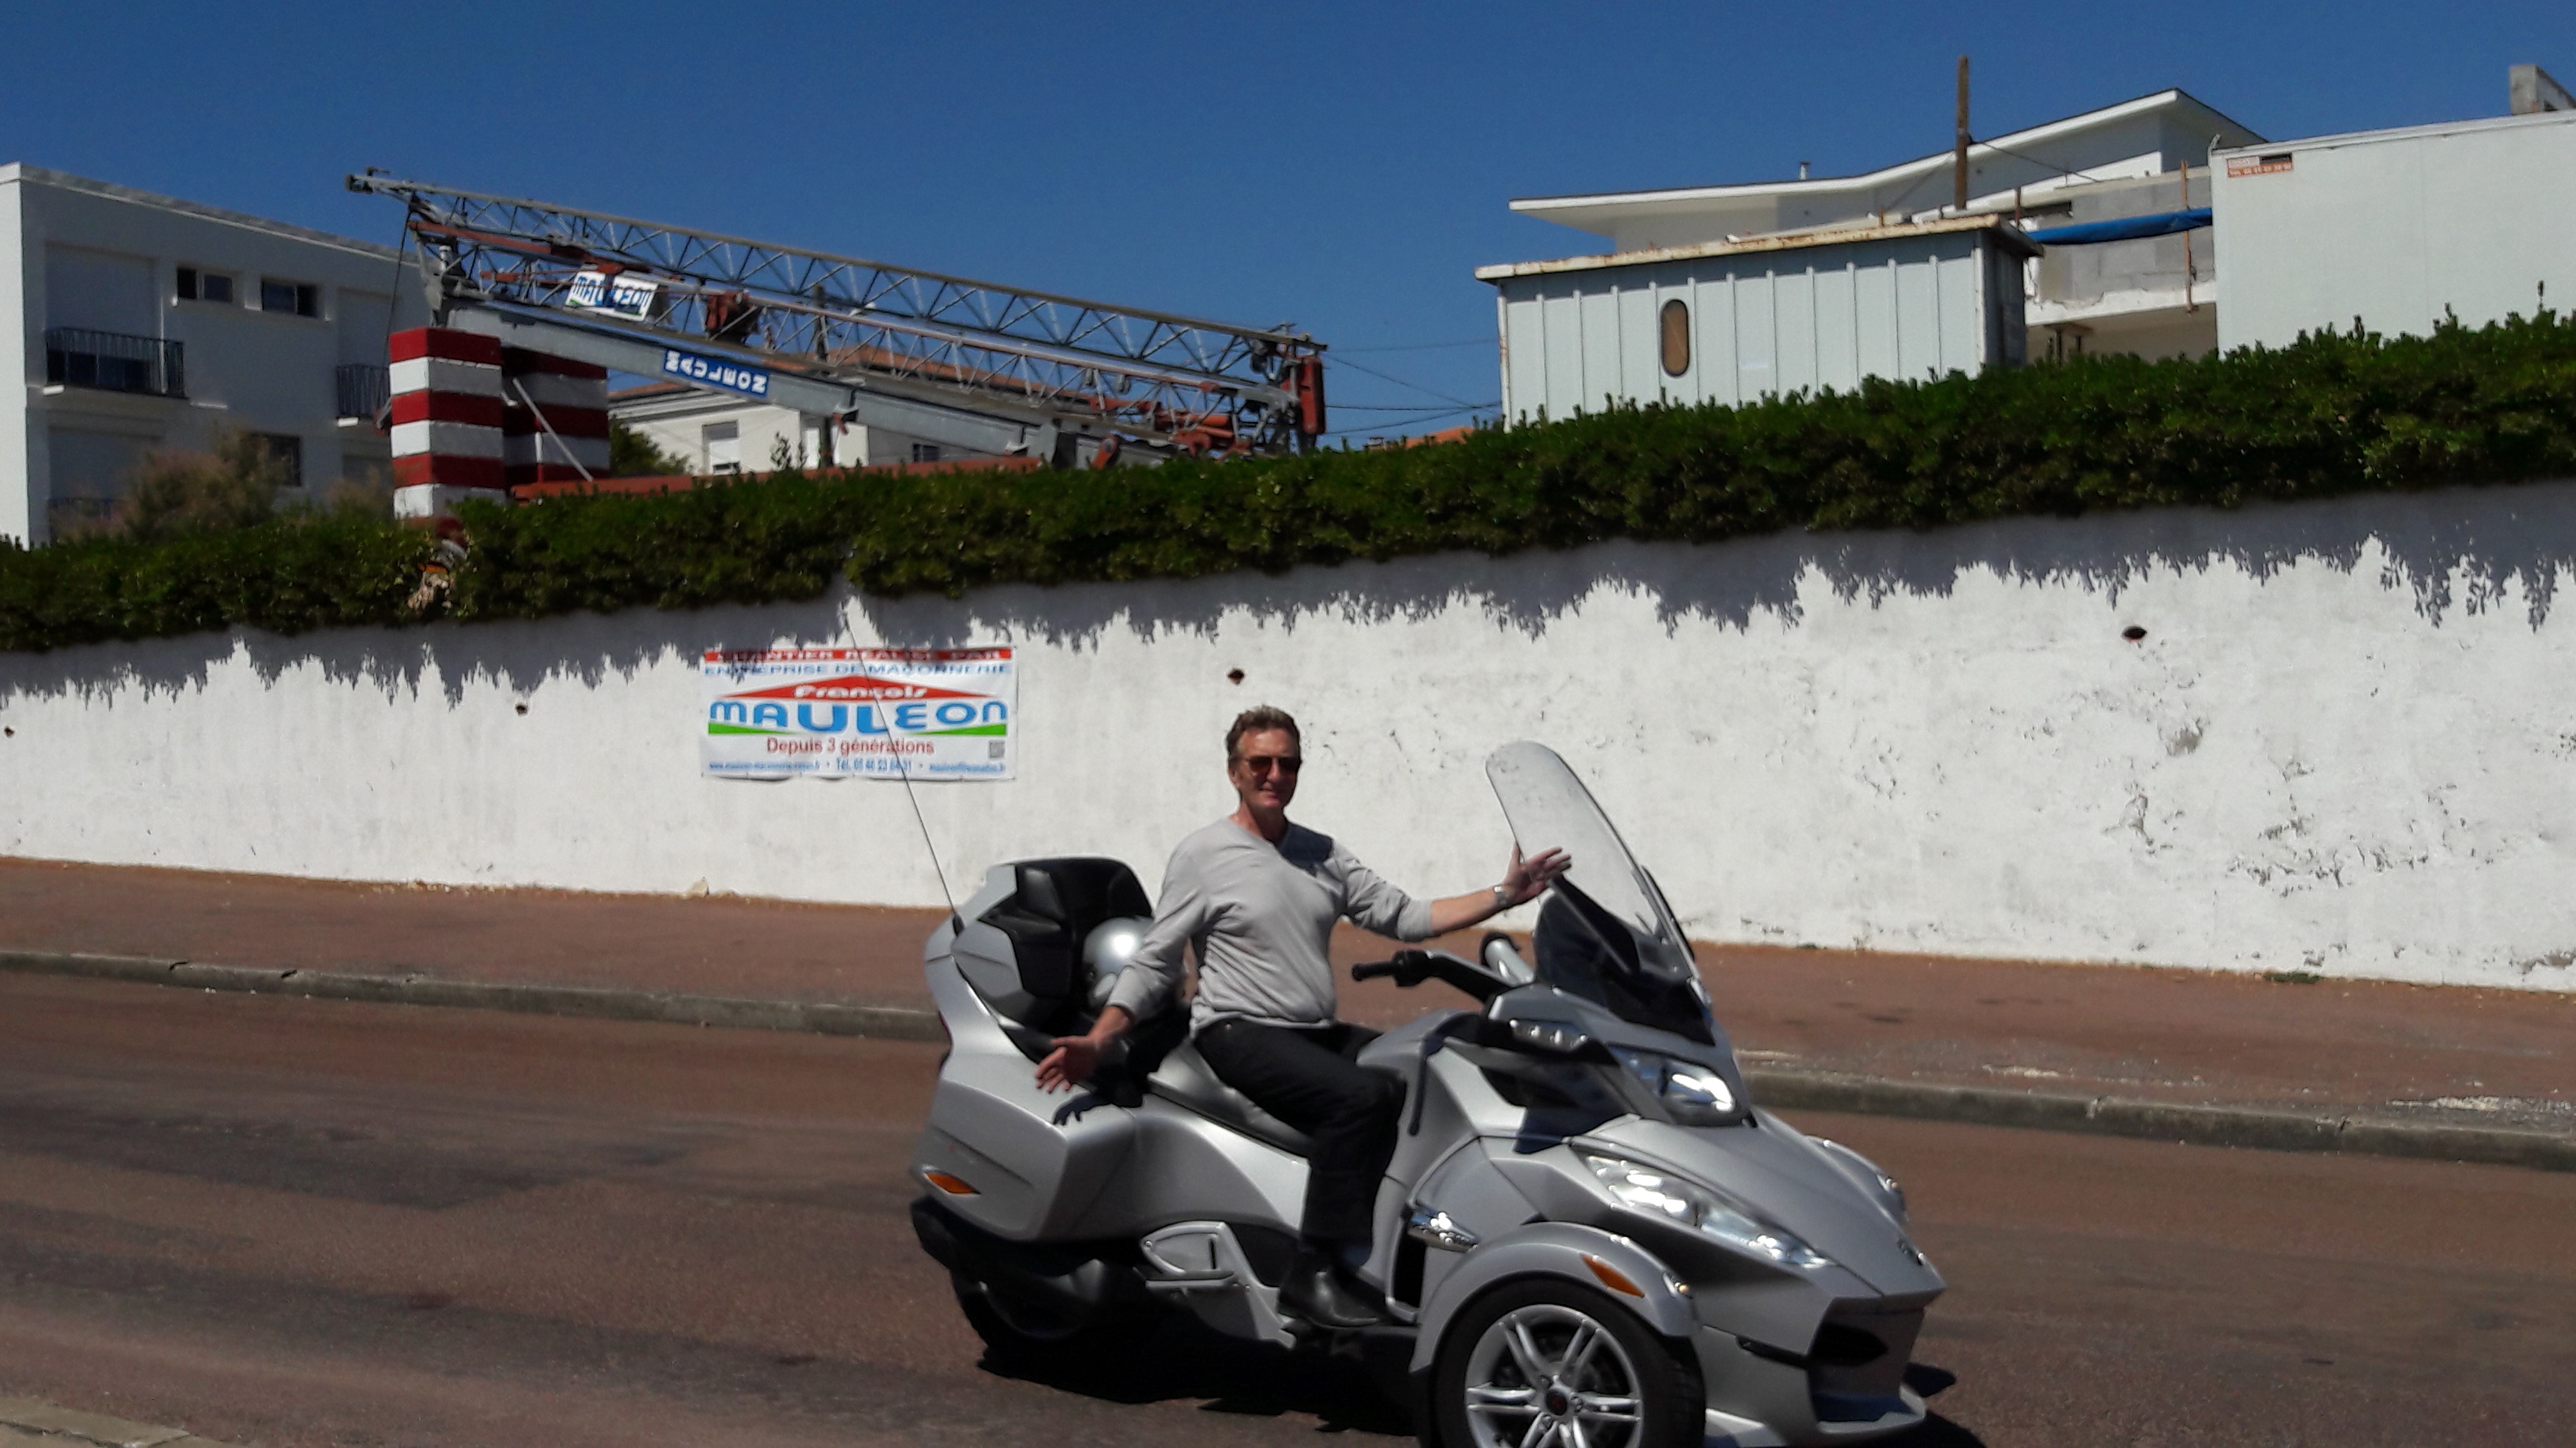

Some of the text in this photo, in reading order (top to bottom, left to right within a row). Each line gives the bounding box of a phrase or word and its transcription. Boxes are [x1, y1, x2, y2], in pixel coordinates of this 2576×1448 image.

[665, 349, 768, 394] MAULEON
[835, 664, 861, 675] DE
[710, 701, 1008, 734] MAULEON
[767, 737, 934, 755] Depuis 3 générations
